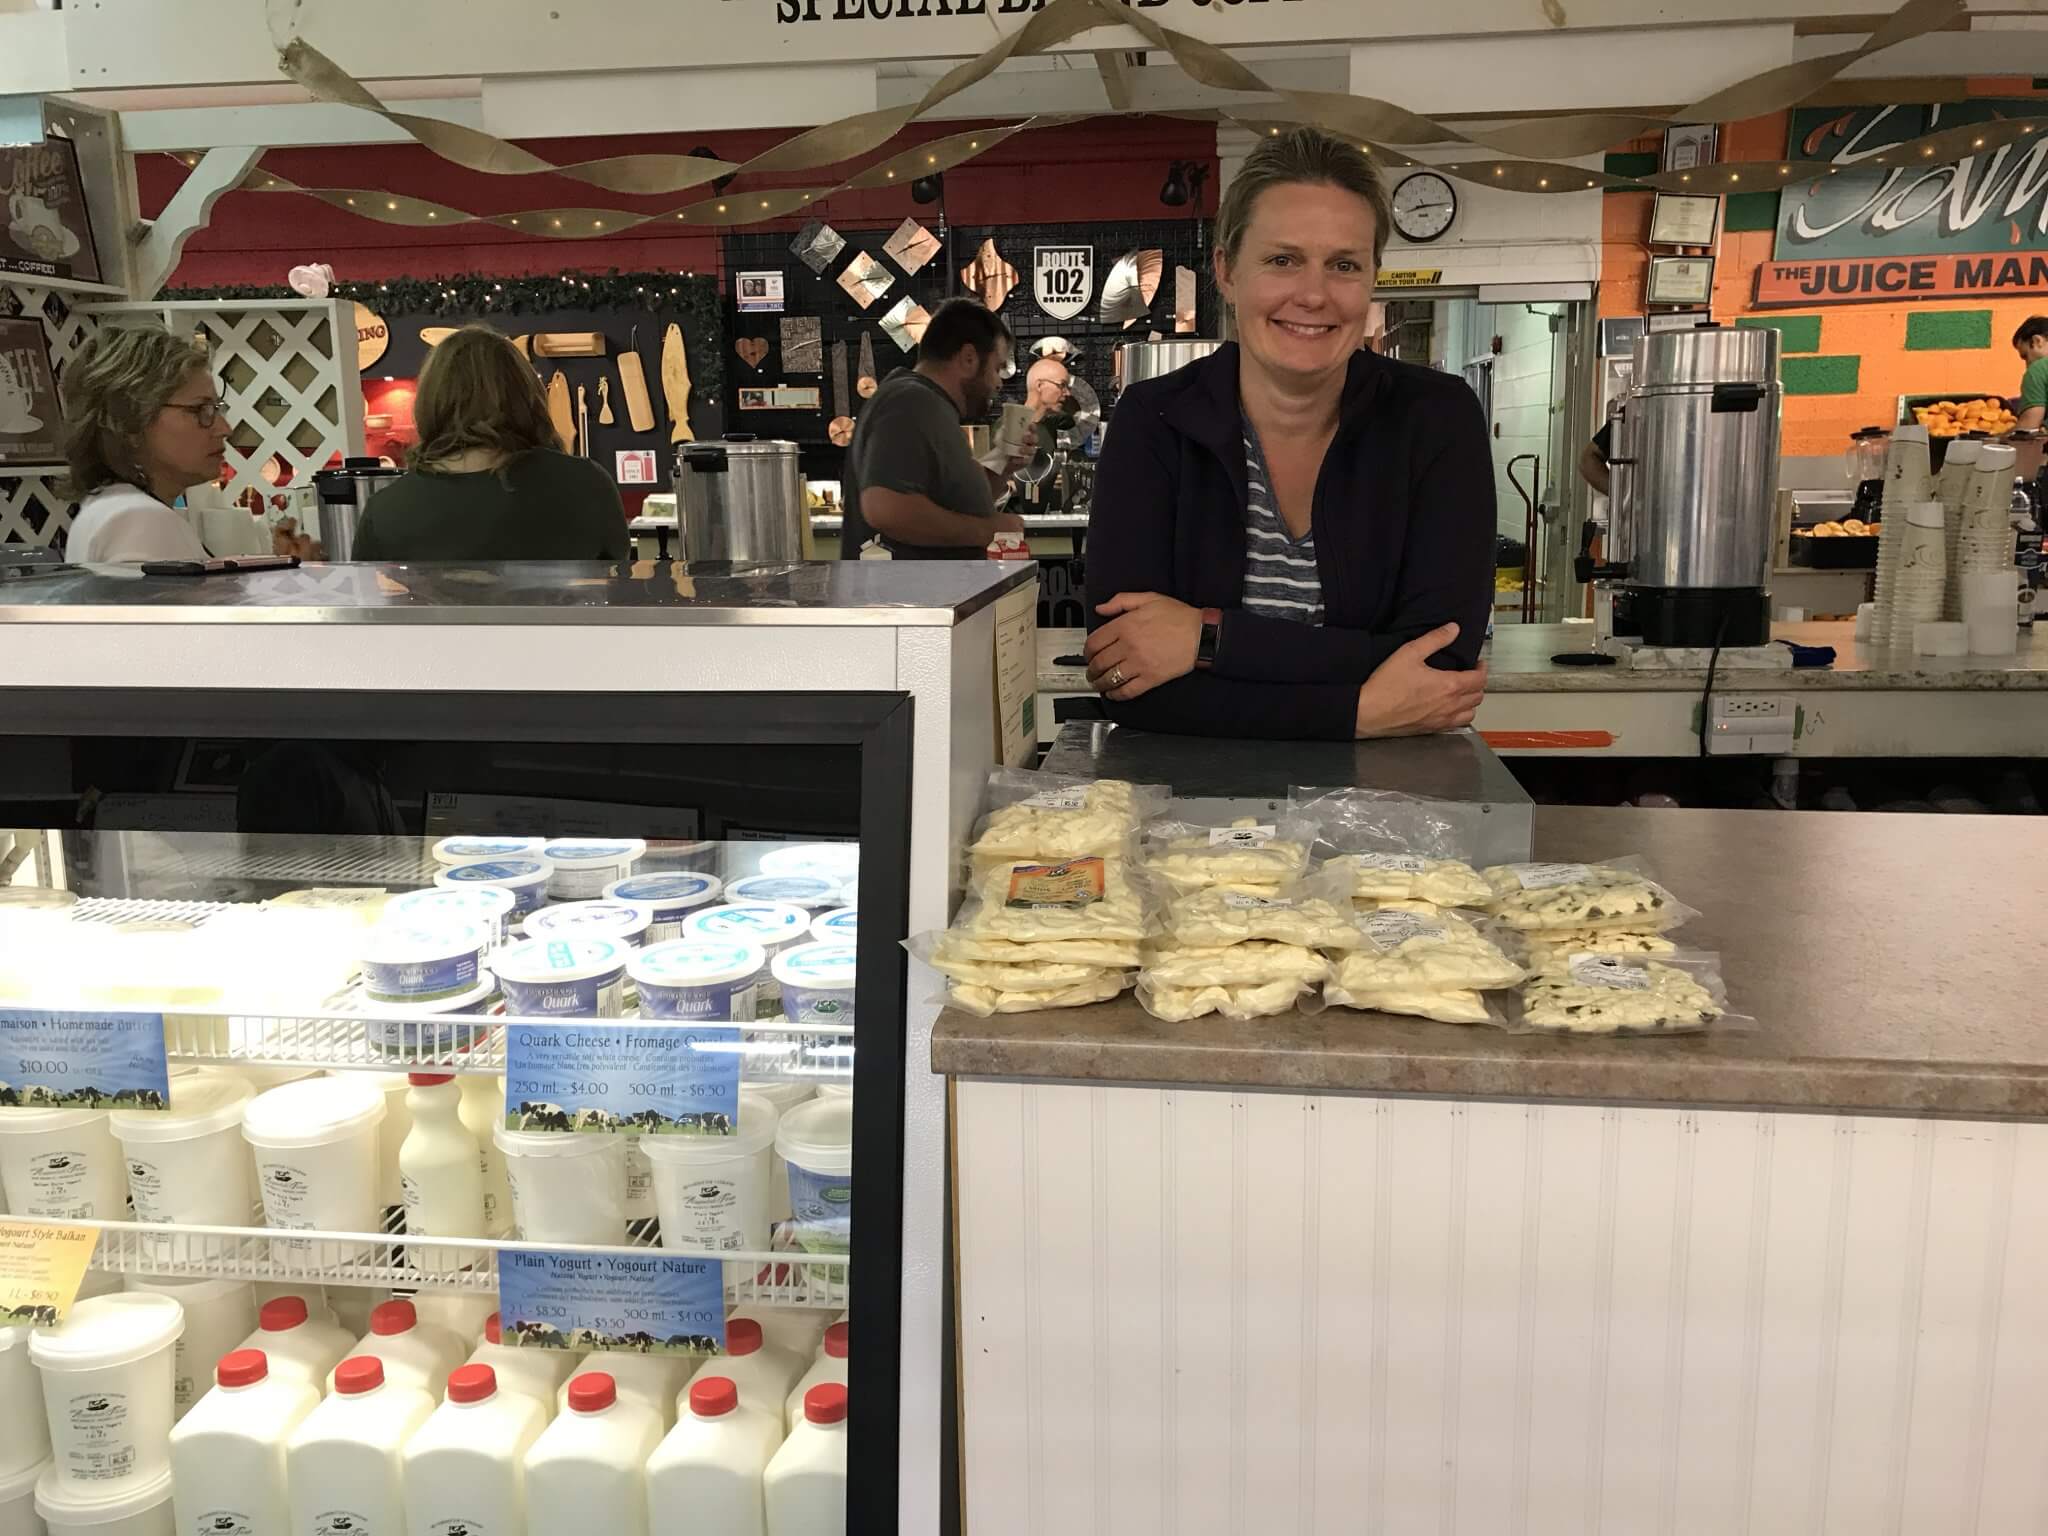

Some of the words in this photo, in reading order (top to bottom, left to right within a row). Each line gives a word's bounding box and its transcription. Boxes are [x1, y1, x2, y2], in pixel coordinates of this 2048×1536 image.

[1042, 251, 1085, 268] ROUTE
[1043, 269, 1084, 295] 102
[1773, 267, 1812, 281] THE
[1801, 260, 1937, 295] JUICE
[1954, 254, 2048, 288] MAN
[542, 993, 580, 1009] Quark
[676, 999, 713, 1013] Quark
[0, 1018, 38, 1029] maison
[50, 1018, 114, 1031] Homemade
[520, 1033, 561, 1048] Quark
[566, 1033, 611, 1048] Cheese
[625, 1034, 680, 1051] Fromage
[19, 1060, 68, 1074] $10.00
[514, 1081, 539, 1093] 250
[571, 1081, 609, 1095] $4.00
[629, 1083, 657, 1095] 500
[690, 1083, 726, 1097] $6.50
[56, 1230, 86, 1241] Balkan
[515, 1254, 545, 1268] Plain
[549, 1256, 592, 1271] Yogurt
[608, 1258, 657, 1273] Yogourt
[663, 1260, 707, 1274] Nature
[536, 1305, 567, 1317] $8.50
[624, 1309, 649, 1320] 500
